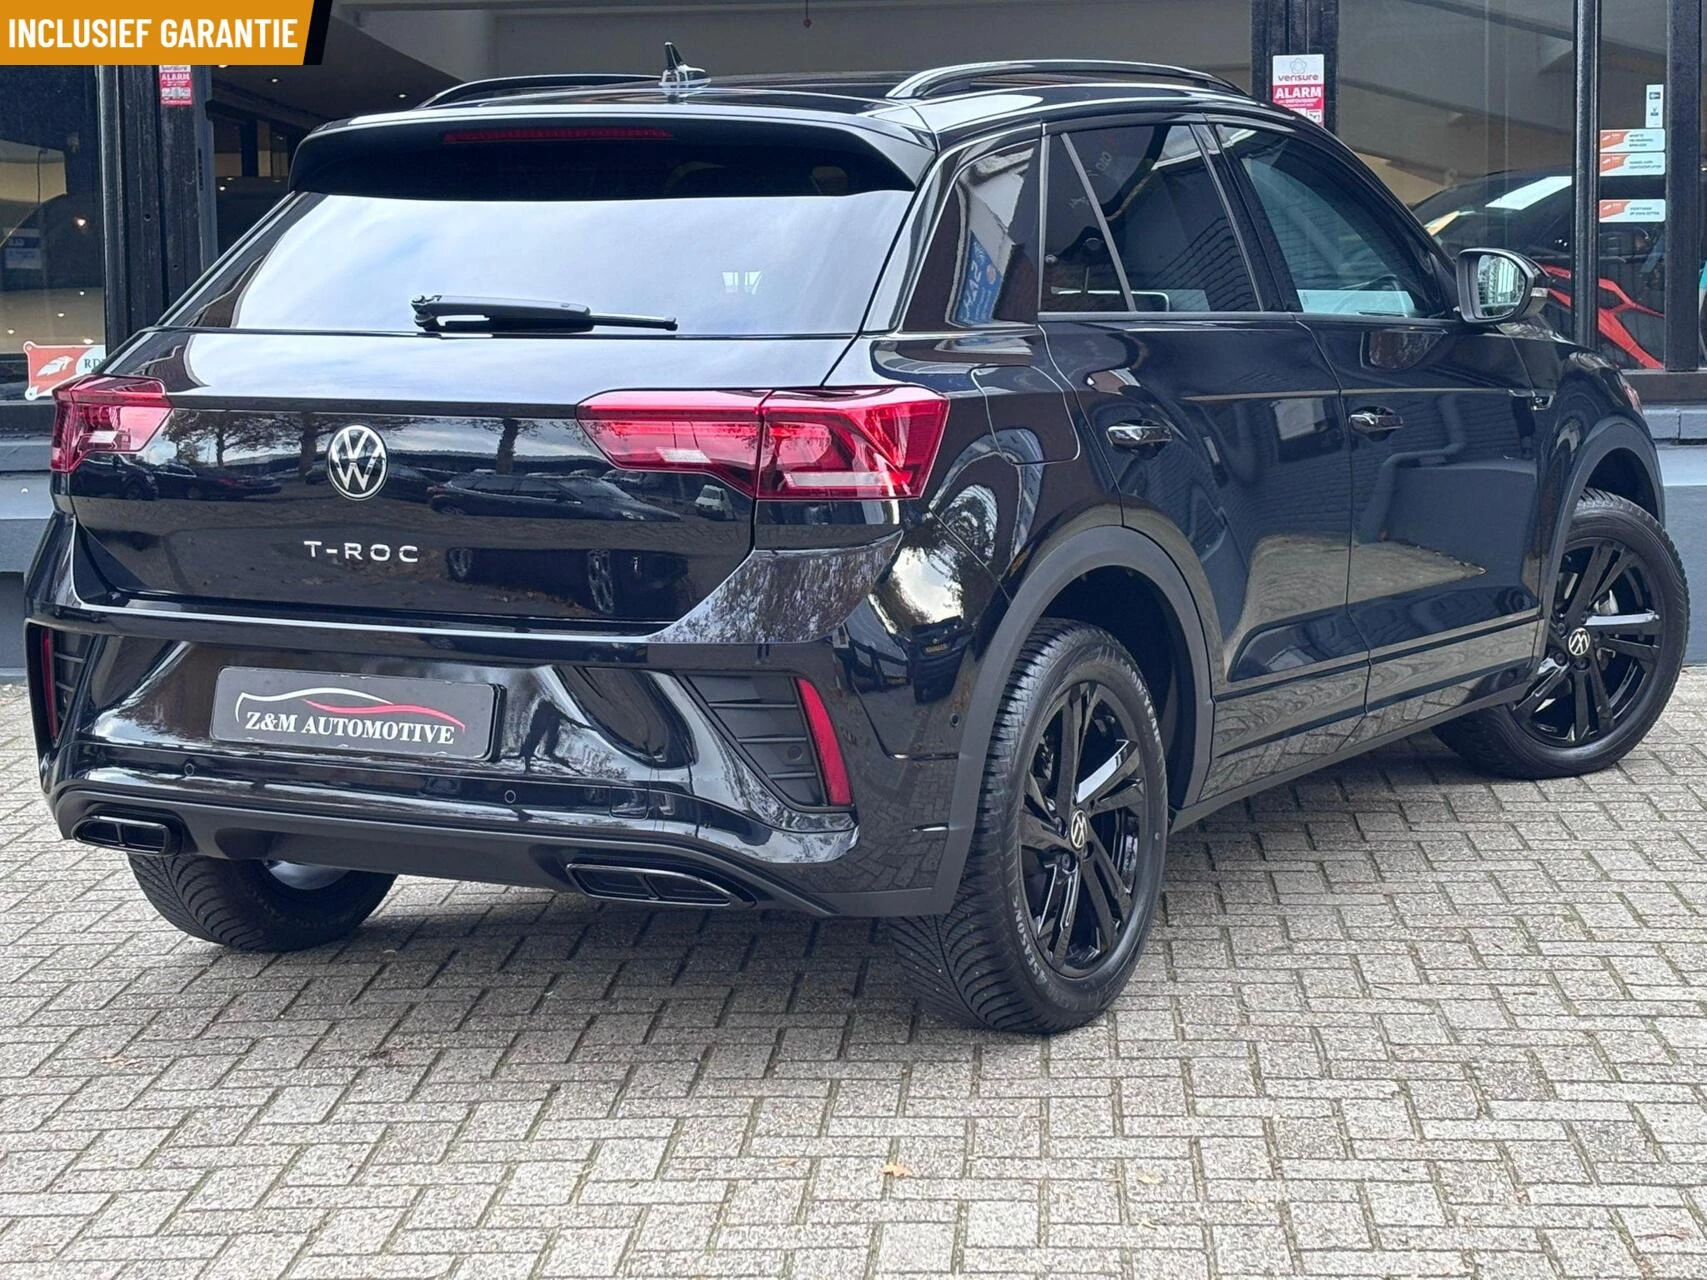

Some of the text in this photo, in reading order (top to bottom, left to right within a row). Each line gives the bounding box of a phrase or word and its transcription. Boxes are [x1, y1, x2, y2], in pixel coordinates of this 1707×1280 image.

[161, 73, 190, 81] ALARM
[1275, 87, 1322, 98] ALARM
[84, 358, 104, 369] RD
[304, 540, 418, 563] T-ROC
[245, 711, 455, 745] Z&M AUTOMOTIVE
